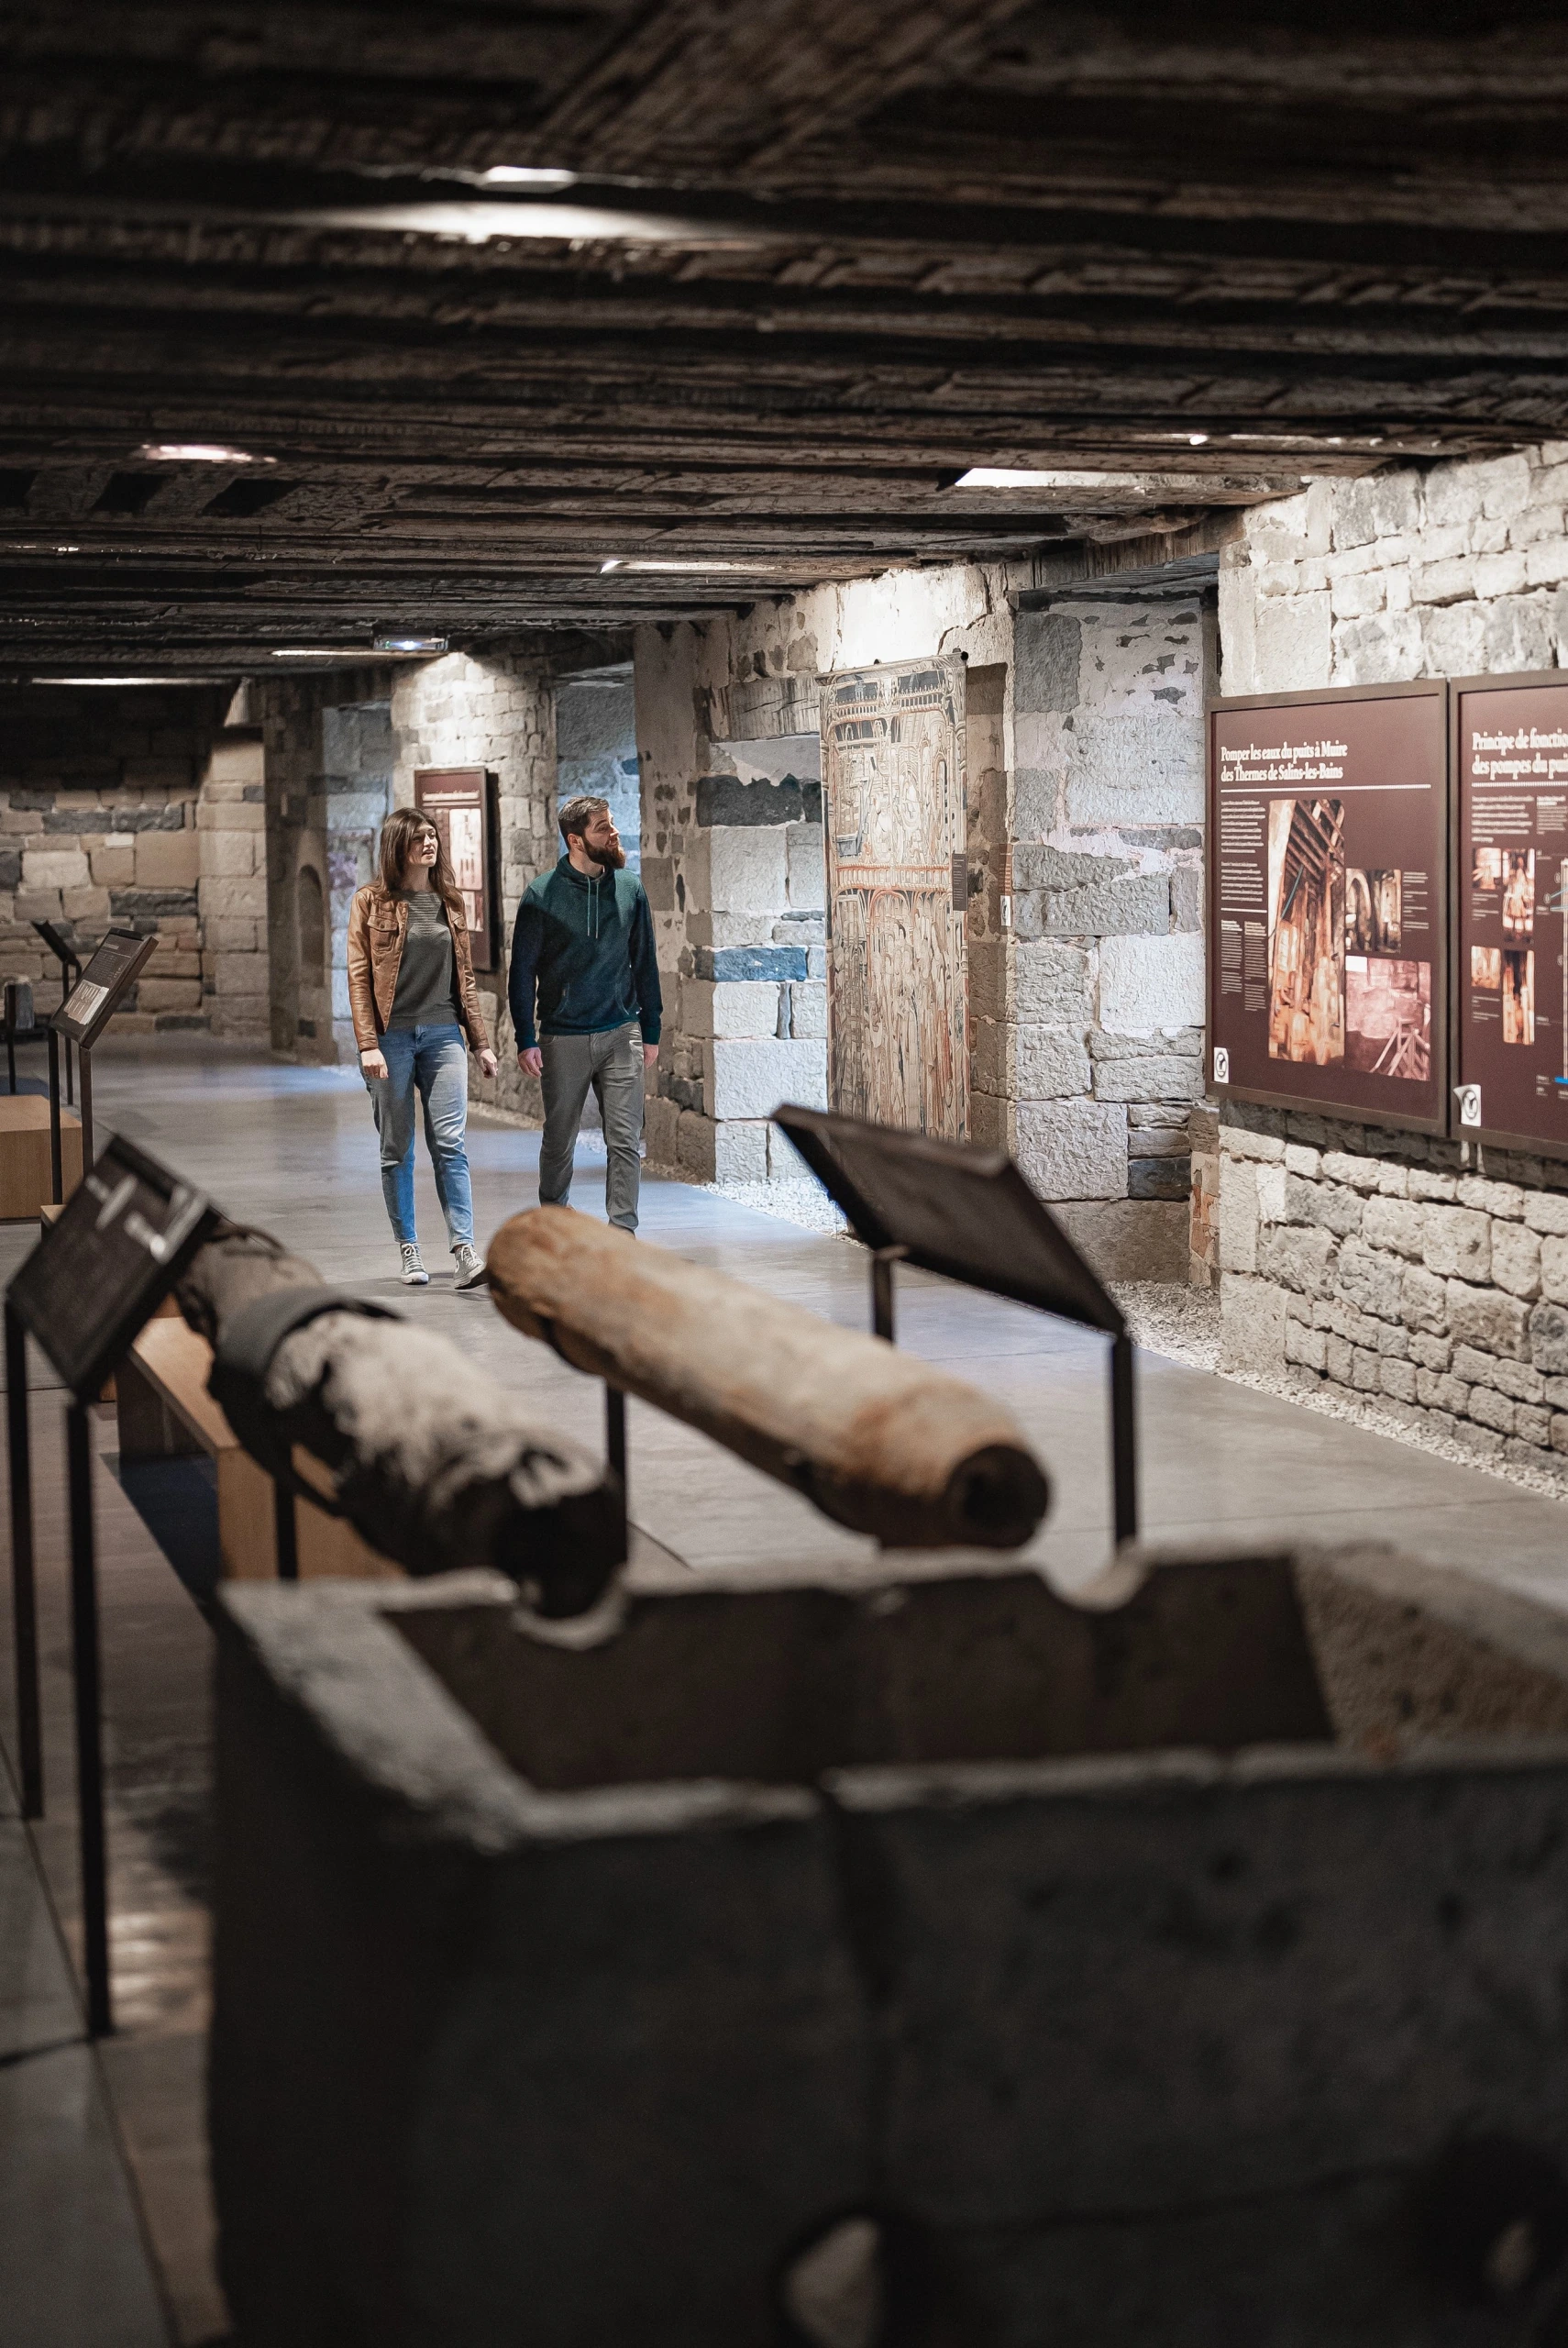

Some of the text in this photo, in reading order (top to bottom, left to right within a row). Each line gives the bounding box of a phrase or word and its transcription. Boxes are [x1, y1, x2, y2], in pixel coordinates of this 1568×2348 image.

[1220, 739, 1348, 766] Pomper les eaux du puits à Muire
[1472, 730, 1515, 756] Principe
[1515, 727, 1529, 749] de
[1220, 761, 1344, 782] des Thermes de Salins-les-Bains
[1472, 754, 1490, 774] des
[1490, 759, 1531, 781] pompes
[1531, 752, 1548, 773] du
